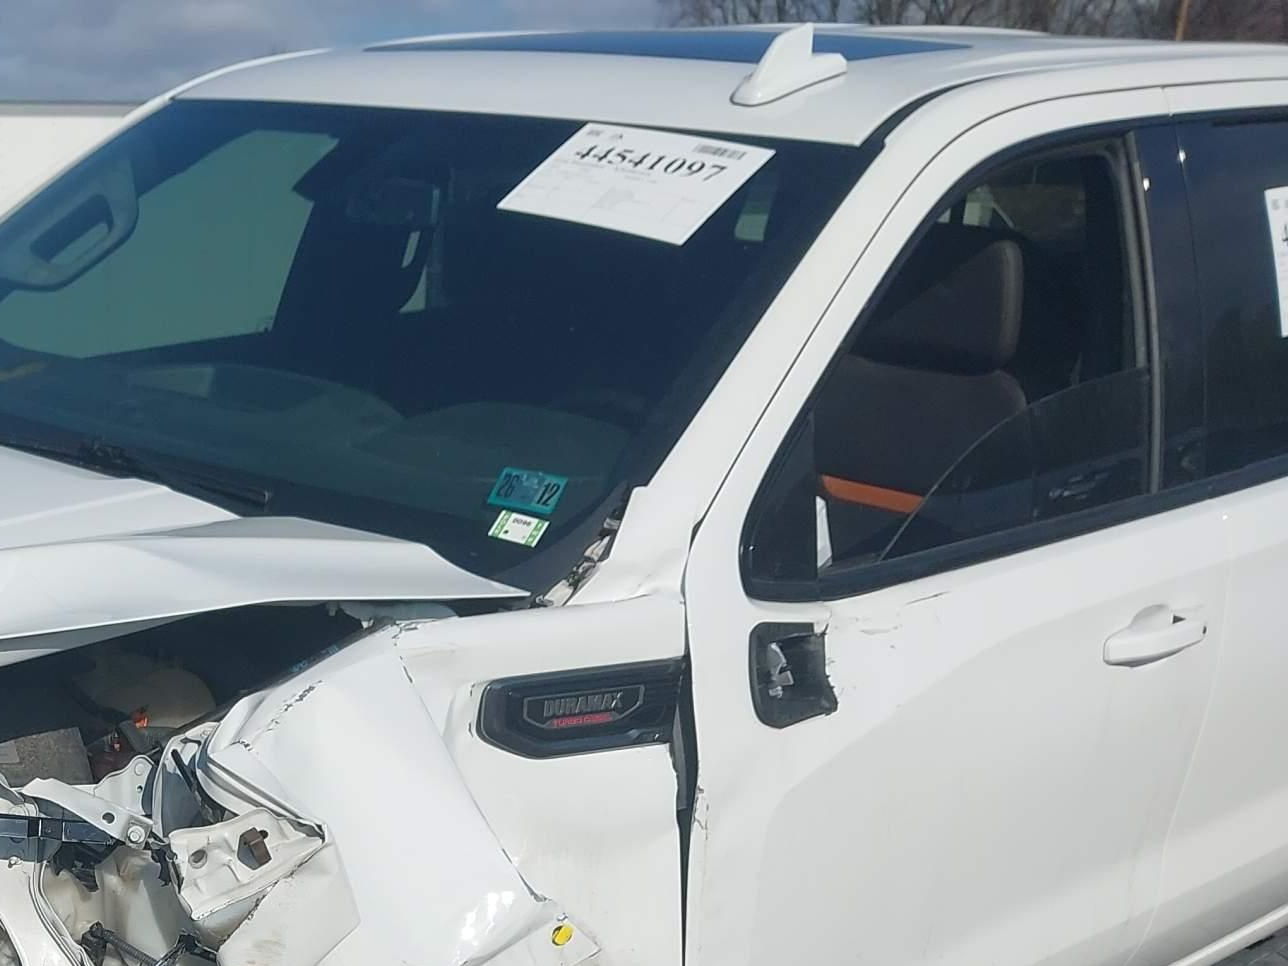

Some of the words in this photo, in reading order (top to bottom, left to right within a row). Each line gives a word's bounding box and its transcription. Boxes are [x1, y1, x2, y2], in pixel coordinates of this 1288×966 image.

[573, 143, 728, 183] 44541097
[535, 482, 561, 507] 12
[544, 691, 624, 717] DURAMAX
